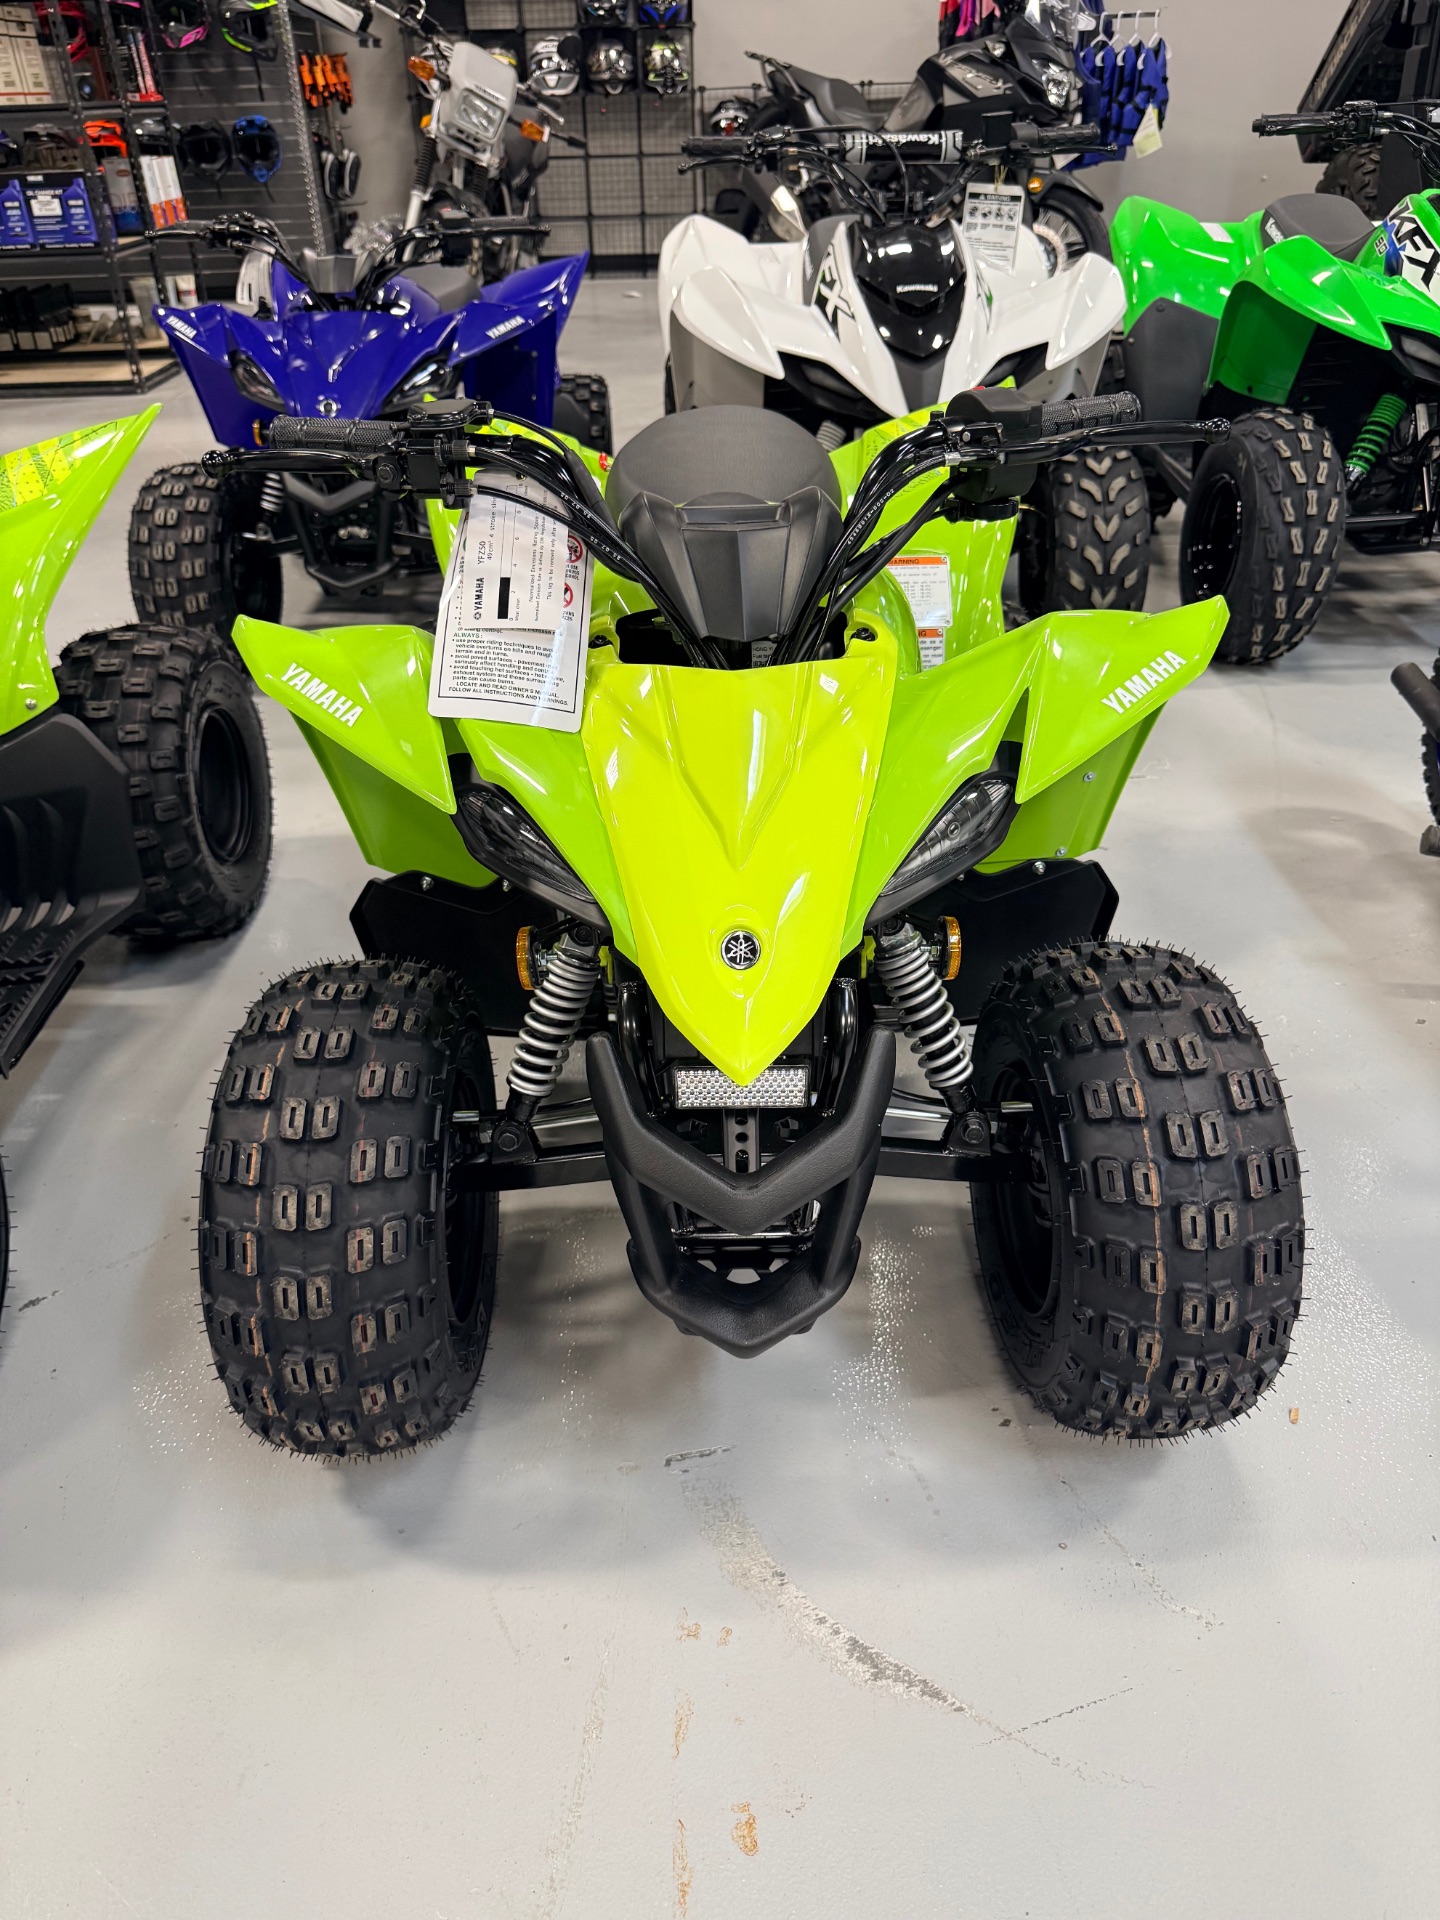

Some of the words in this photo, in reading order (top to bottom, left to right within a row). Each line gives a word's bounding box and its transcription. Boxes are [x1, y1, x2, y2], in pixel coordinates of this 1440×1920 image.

[166, 315, 197, 339] YAMAHA
[485, 315, 525, 339] YAMAHA
[478, 540, 487, 565] YFZ50
[474, 577, 485, 611] YAMAHA
[503, 641, 534, 650] techniques
[512, 646, 524, 654] hills
[497, 662, 522, 670] handling
[517, 660, 545, 668] pavement
[508, 685, 534, 693] OWNER'S
[1101, 650, 1188, 715] YAMAHA
[281, 662, 364, 728] YAMAHA
[484, 689, 524, 698] INSTRUCTIONS
